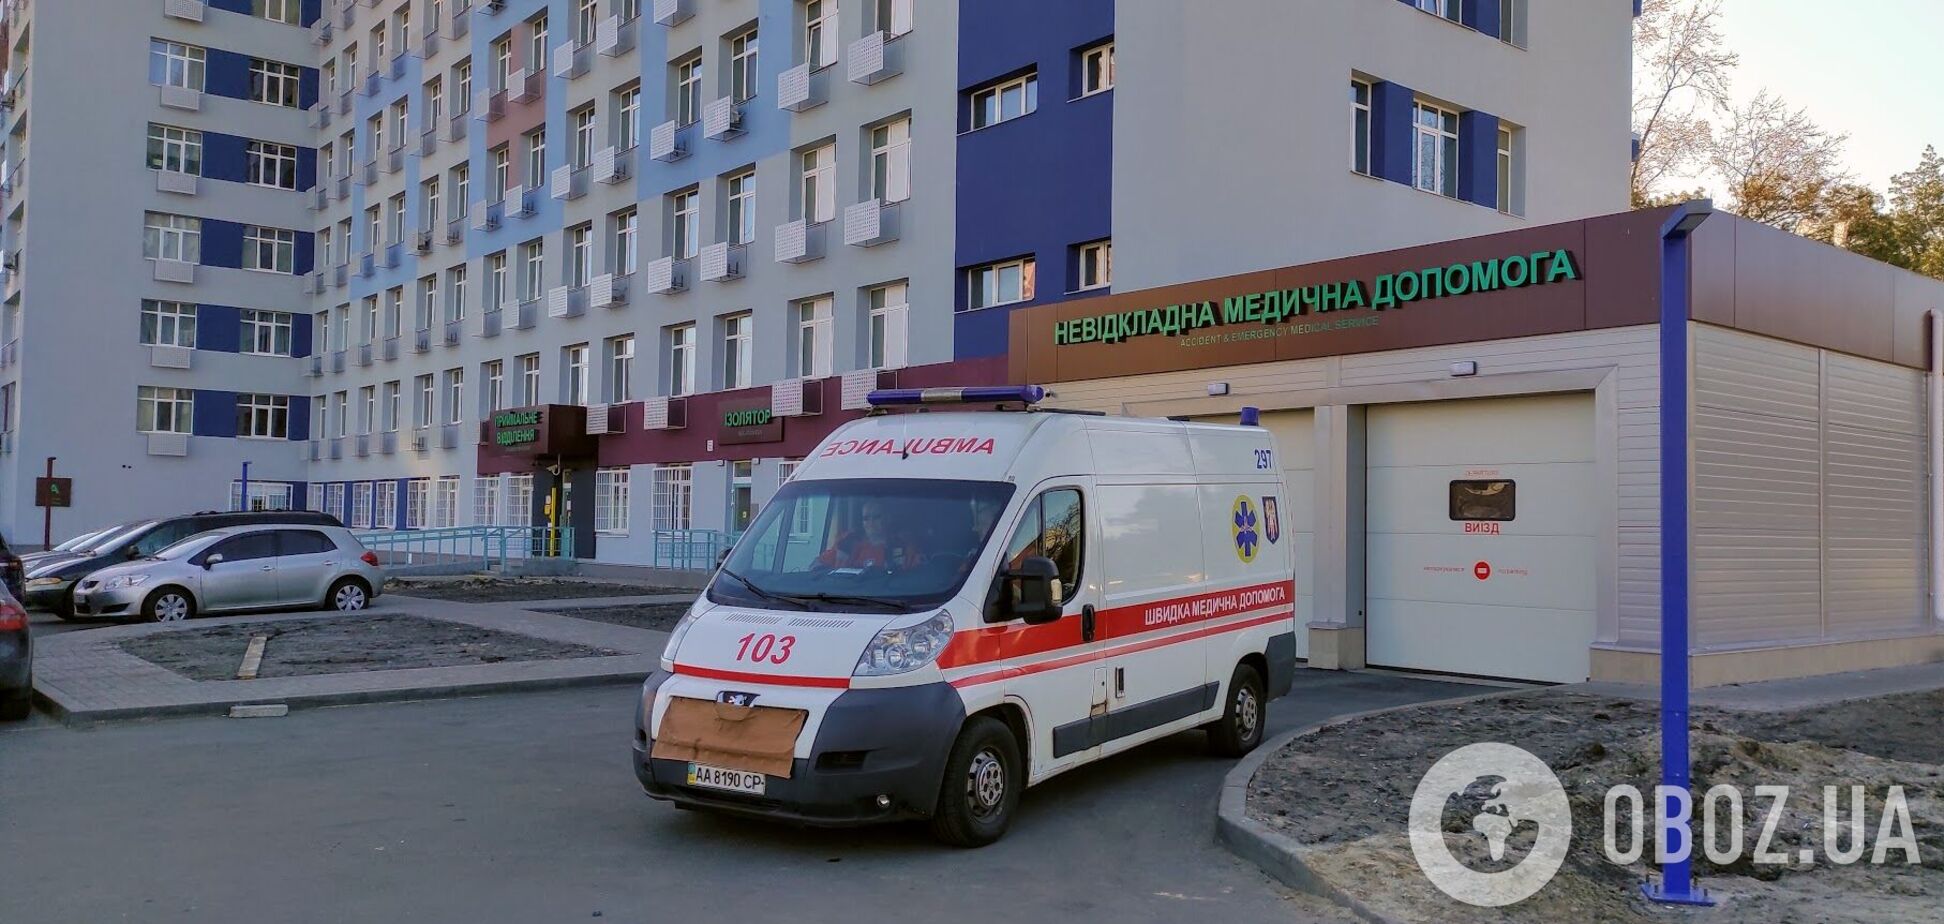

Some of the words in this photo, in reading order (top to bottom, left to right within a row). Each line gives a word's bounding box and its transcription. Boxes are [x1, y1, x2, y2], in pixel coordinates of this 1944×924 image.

[1054, 300, 1216, 346] НЕВІДКЛАДНА
[1224, 279, 1365, 326] МЕДИЧНА
[1371, 248, 1576, 311] ДОПОМОГА
[1180, 334, 1222, 347] ACCIDENT
[1231, 327, 1288, 342] EMERGENCY
[1290, 321, 1331, 336] MEDICAL
[1335, 315, 1379, 331] SERVICE
[725, 409, 770, 426] ІЗОЛЯТОР
[1255, 449, 1271, 469] 297
[1145, 604, 1190, 626] ШВИДКА
[1191, 595, 1238, 617] МЕДИЧНА
[1239, 586, 1286, 611] ДОПОМОГА
[736, 633, 796, 665] 103
[696, 767, 711, 783] AA
[714, 770, 740, 787] 8190
[743, 775, 761, 789] CP
